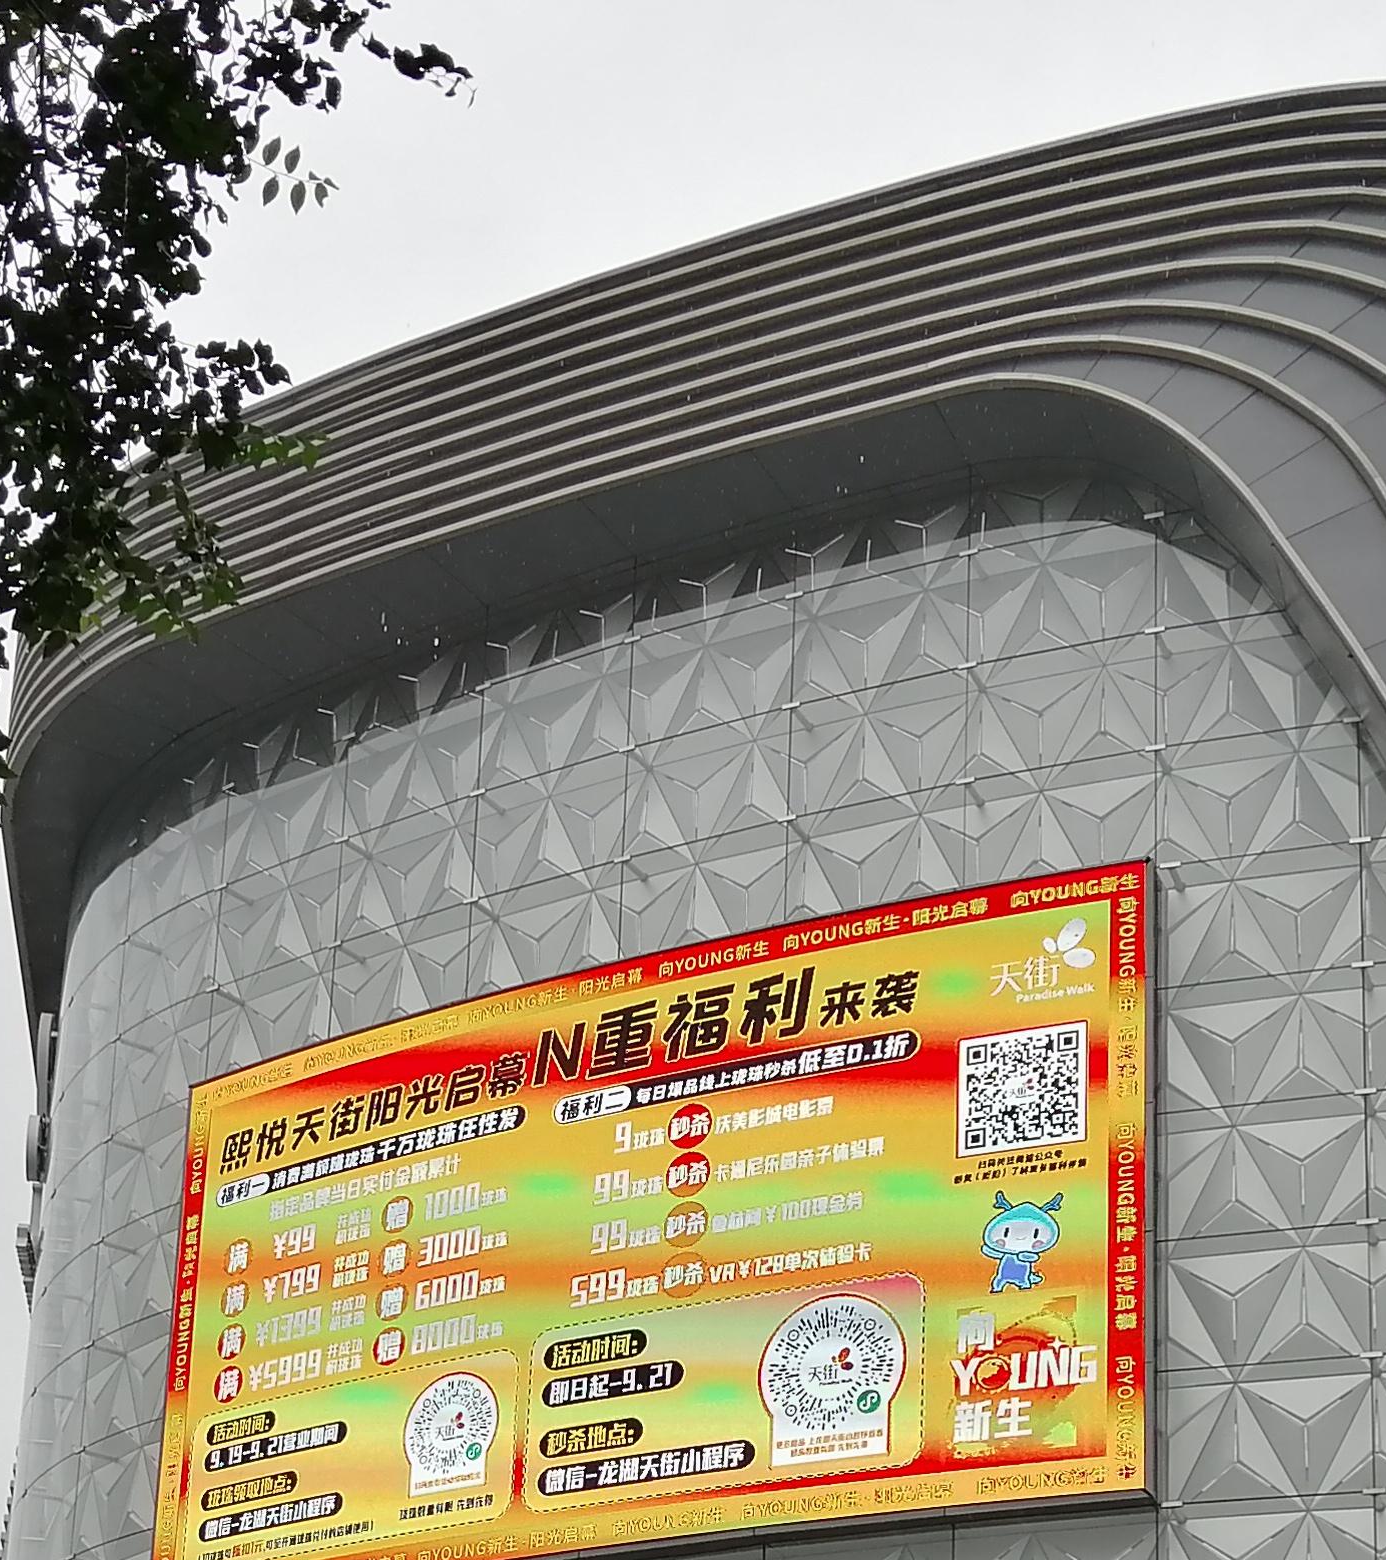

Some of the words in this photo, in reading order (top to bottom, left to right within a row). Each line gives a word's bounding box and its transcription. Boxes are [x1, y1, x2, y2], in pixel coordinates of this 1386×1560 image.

[658, 939, 770, 978] 向YOUNG新生
[990, 953, 1061, 998] 天街
[1015, 988, 1063, 1004] Paradise
[1065, 982, 1095, 998] Walk
[559, 1088, 626, 1122] 福利二
[668, 1111, 711, 1141] 秒杀
[667, 1159, 708, 1188] 秒杀
[665, 1209, 708, 1239] 秒杀
[262, 1262, 322, 1304] ¥799
[663, 1260, 705, 1290] 秒杀
[957, 1311, 995, 1354] 向
[549, 1334, 639, 1369] 活动时间:
[248, 1349, 322, 1392] ¥5999
[950, 1345, 1098, 1397] YOUNG
[952, 1395, 1033, 1444] 新生
[547, 1423, 635, 1456] 秒杀地点:
[544, 1446, 747, 1494] 微信-龙湖天街小程序
